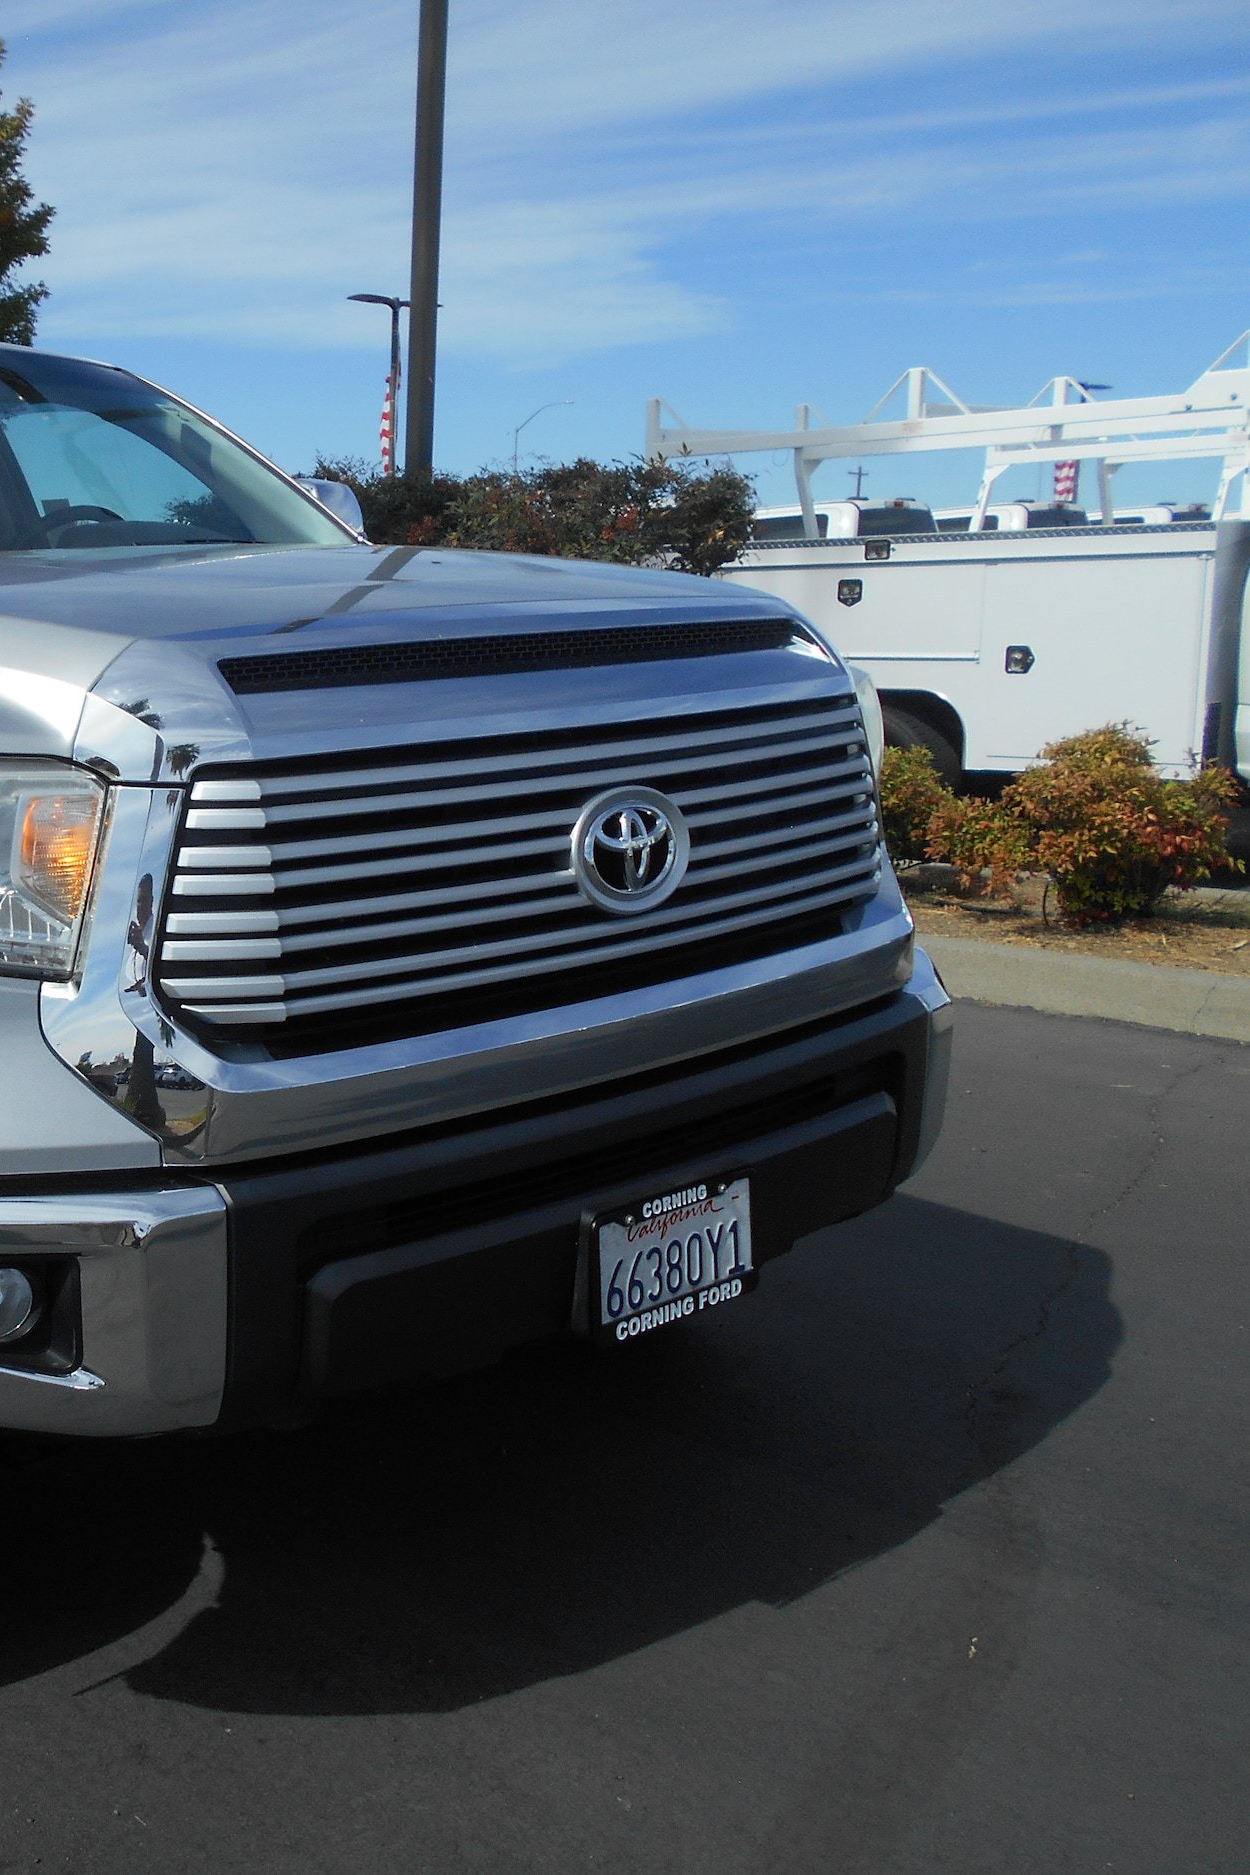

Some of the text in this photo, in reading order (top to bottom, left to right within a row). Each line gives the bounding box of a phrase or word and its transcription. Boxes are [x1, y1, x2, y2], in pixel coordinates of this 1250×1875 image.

[626, 1199, 724, 1242] California
[642, 1184, 707, 1218] CORNING
[607, 1220, 745, 1319] 66380Y1
[616, 1278, 742, 1341] CORNING FORD
